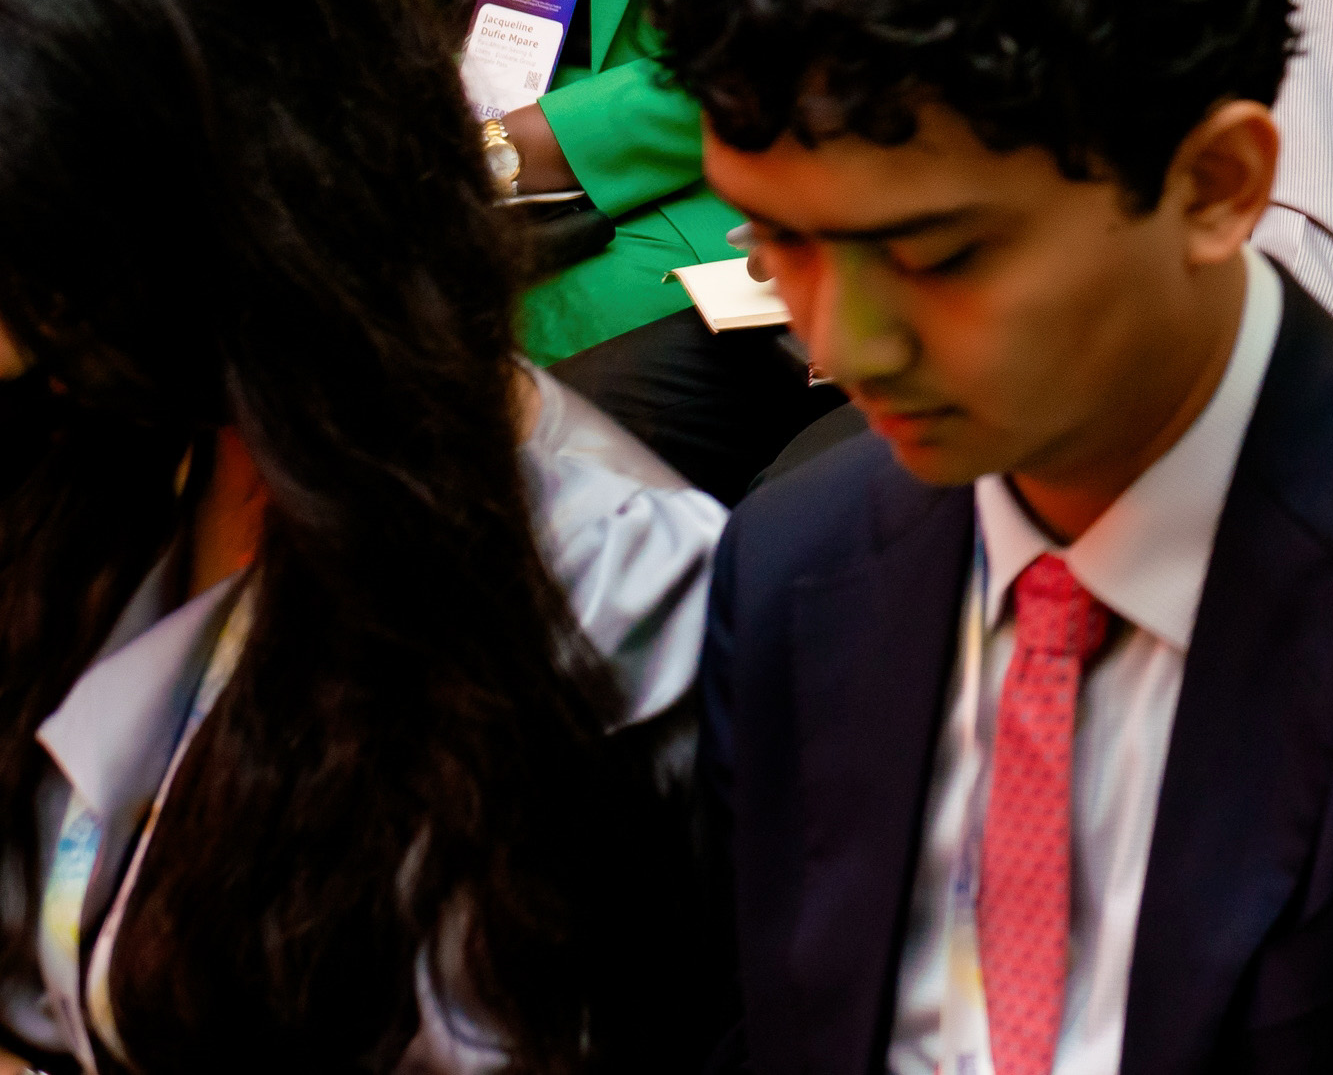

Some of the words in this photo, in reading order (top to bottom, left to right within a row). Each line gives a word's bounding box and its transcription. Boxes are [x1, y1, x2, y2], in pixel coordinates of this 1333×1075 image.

[483, 14, 534, 34] Jacqueline
[481, 27, 505, 40] Dufie
[508, 33, 539, 48] Mpare
